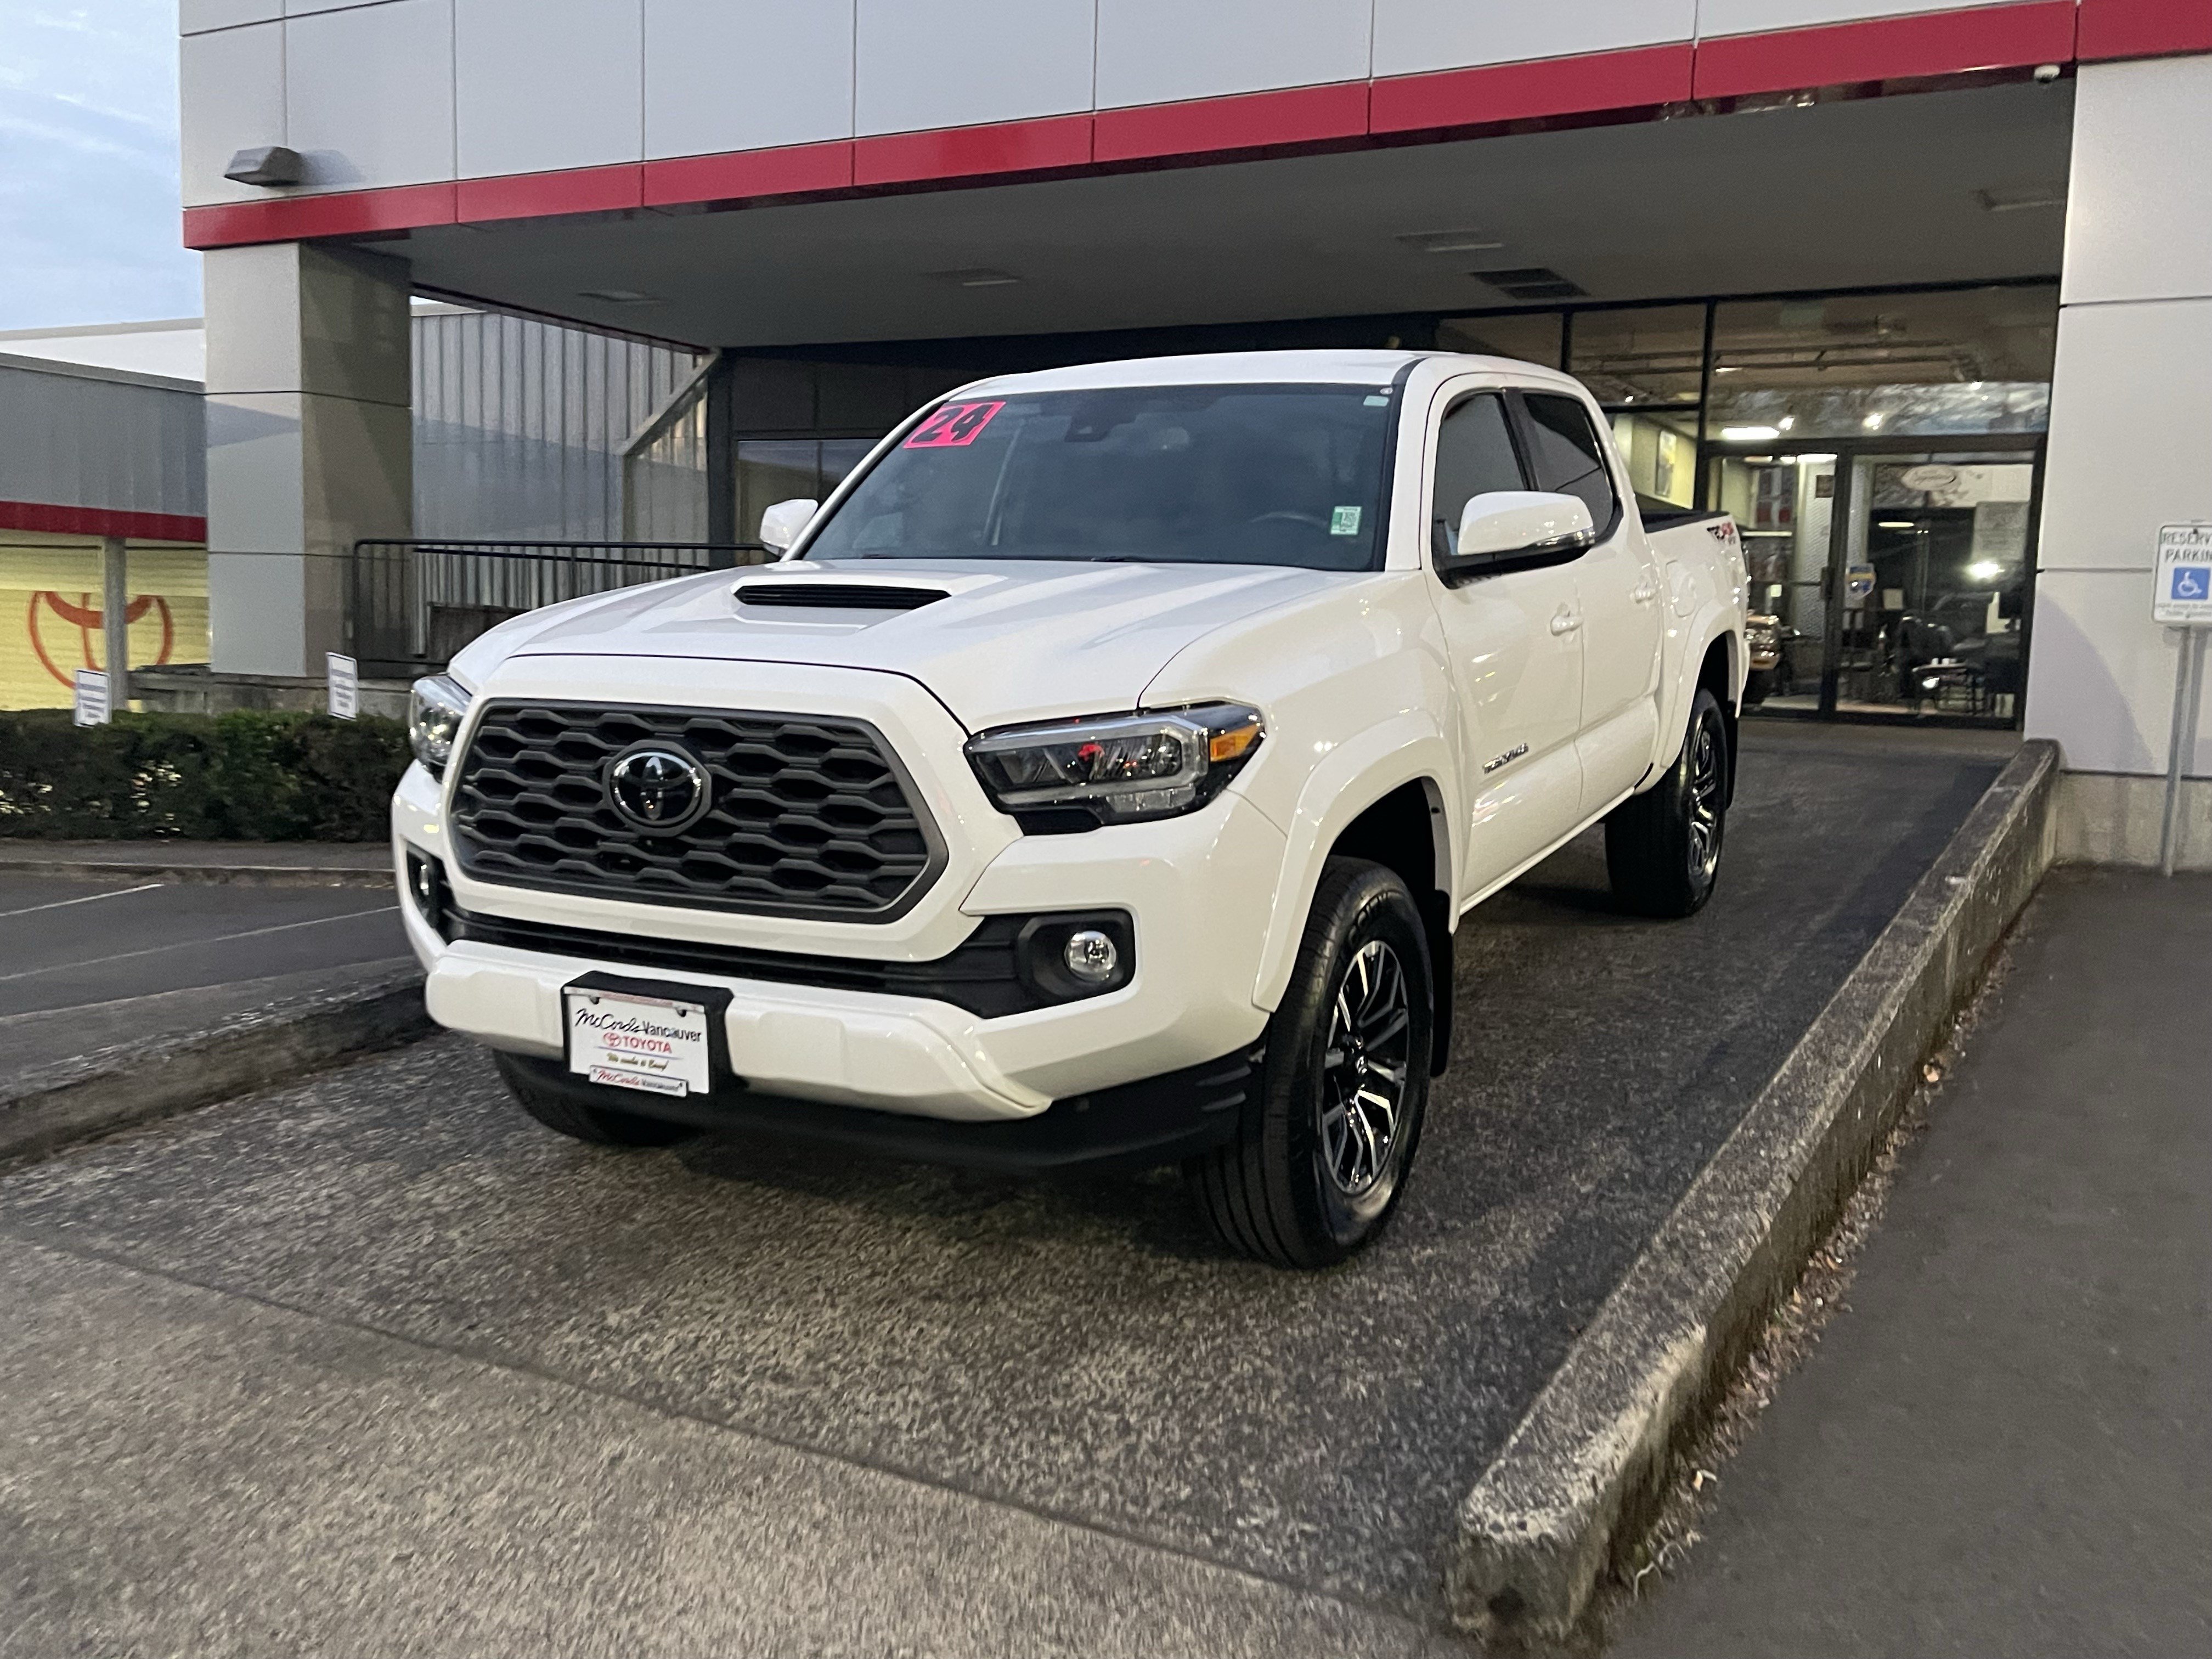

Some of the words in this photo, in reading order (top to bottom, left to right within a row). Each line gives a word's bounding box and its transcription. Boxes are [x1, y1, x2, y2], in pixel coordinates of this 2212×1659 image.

[911, 404, 994, 443] 24
[642, 1020, 702, 1042] Vancouver
[622, 1035, 673, 1054] TOYOTA
